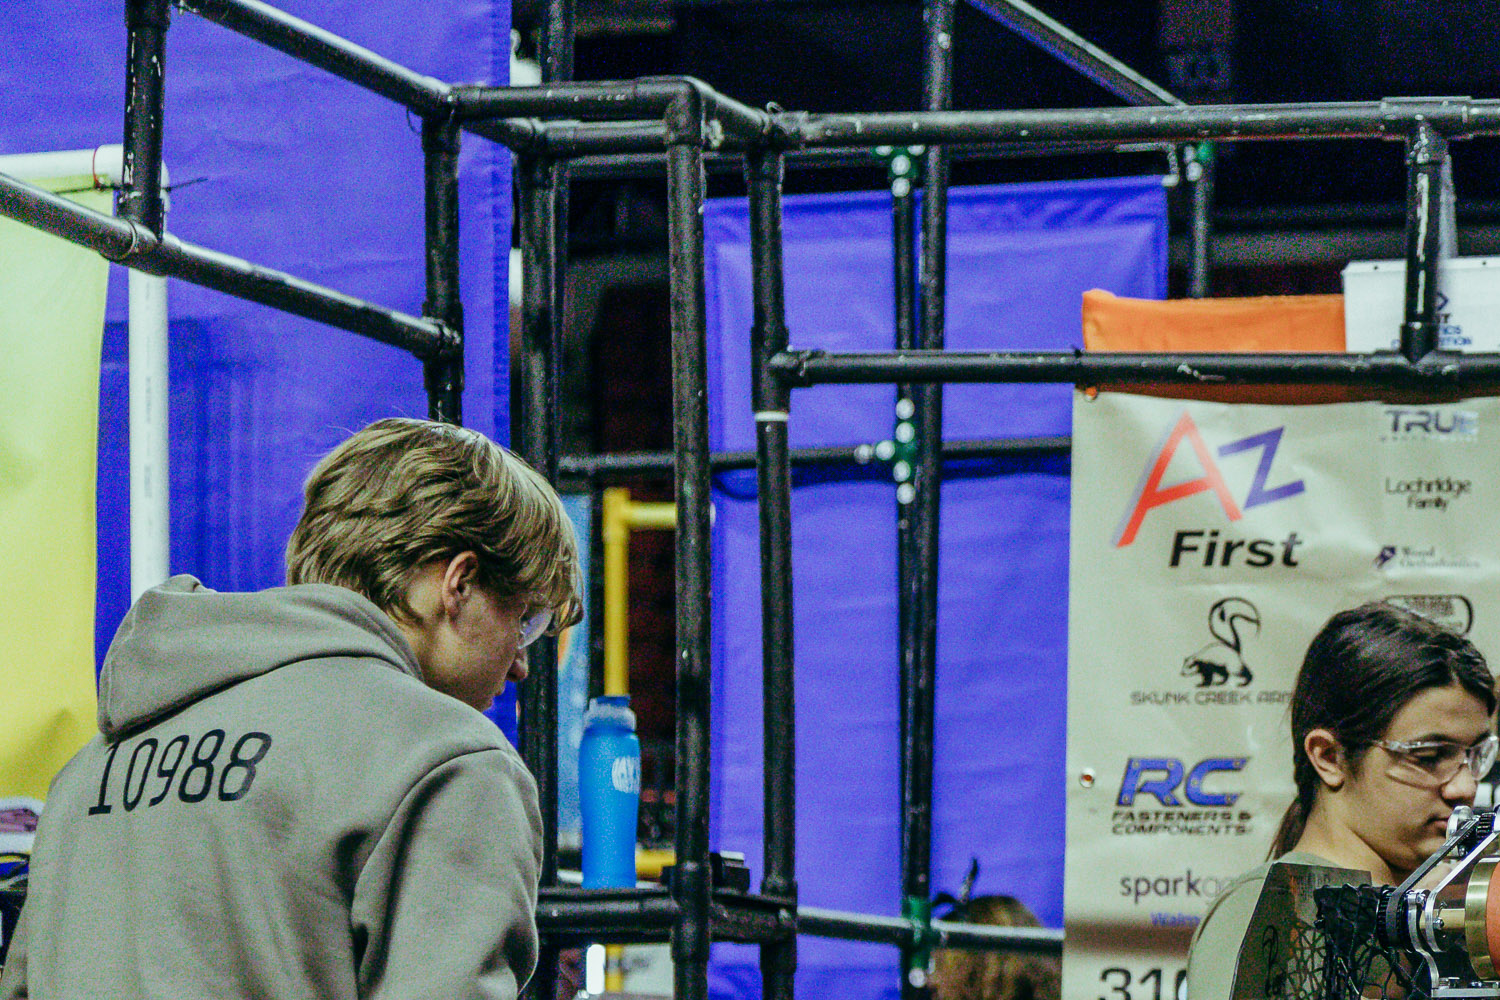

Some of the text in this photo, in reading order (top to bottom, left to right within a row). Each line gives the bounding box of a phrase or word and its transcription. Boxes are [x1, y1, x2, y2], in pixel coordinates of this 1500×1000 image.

[1168, 530, 1304, 569] First
[1131, 690, 1189, 706] SKUNK
[1194, 690, 1250, 705] CREEK
[88, 728, 273, 816] 10988
[1115, 756, 1253, 808] RC
[1112, 810, 1233, 823] FASTENERS
